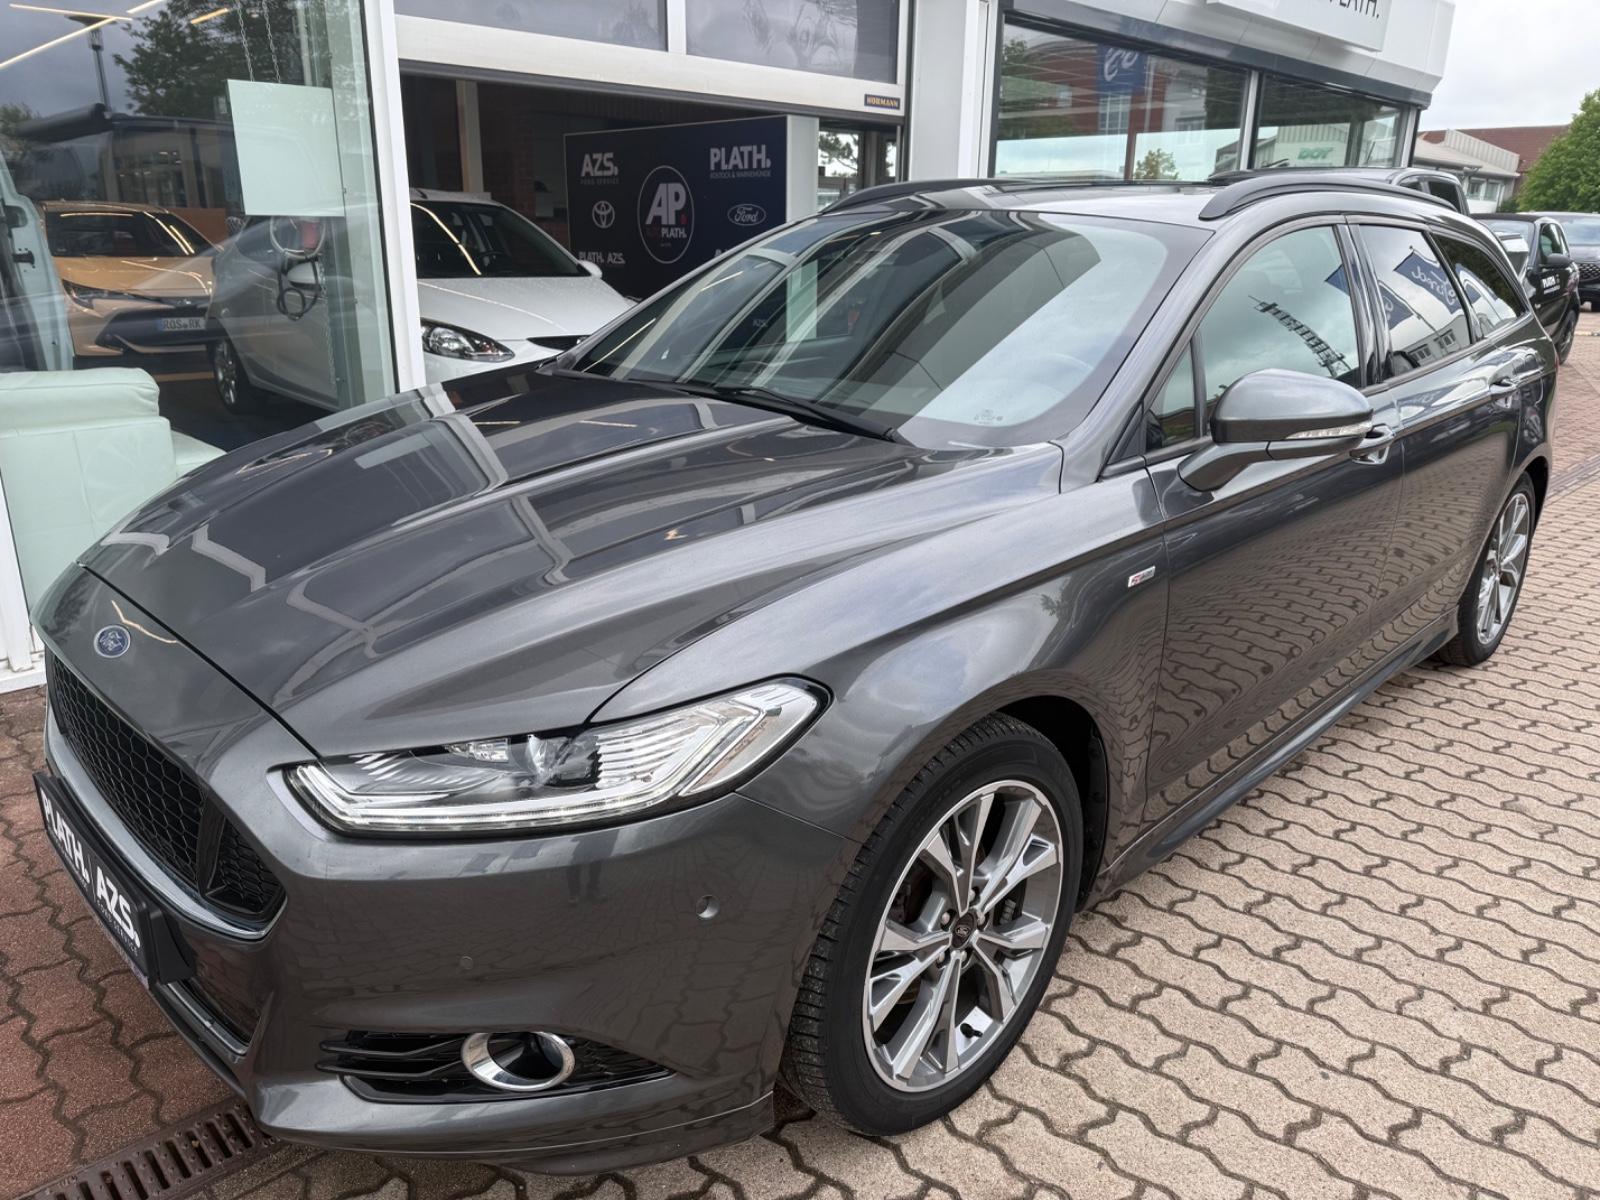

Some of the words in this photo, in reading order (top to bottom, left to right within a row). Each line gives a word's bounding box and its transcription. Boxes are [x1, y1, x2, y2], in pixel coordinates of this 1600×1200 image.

[580, 152, 619, 177] AZS.
[710, 144, 771, 170] PLATH.
[40, 786, 91, 885] PLATH.
[96, 865, 141, 949] AZS.
